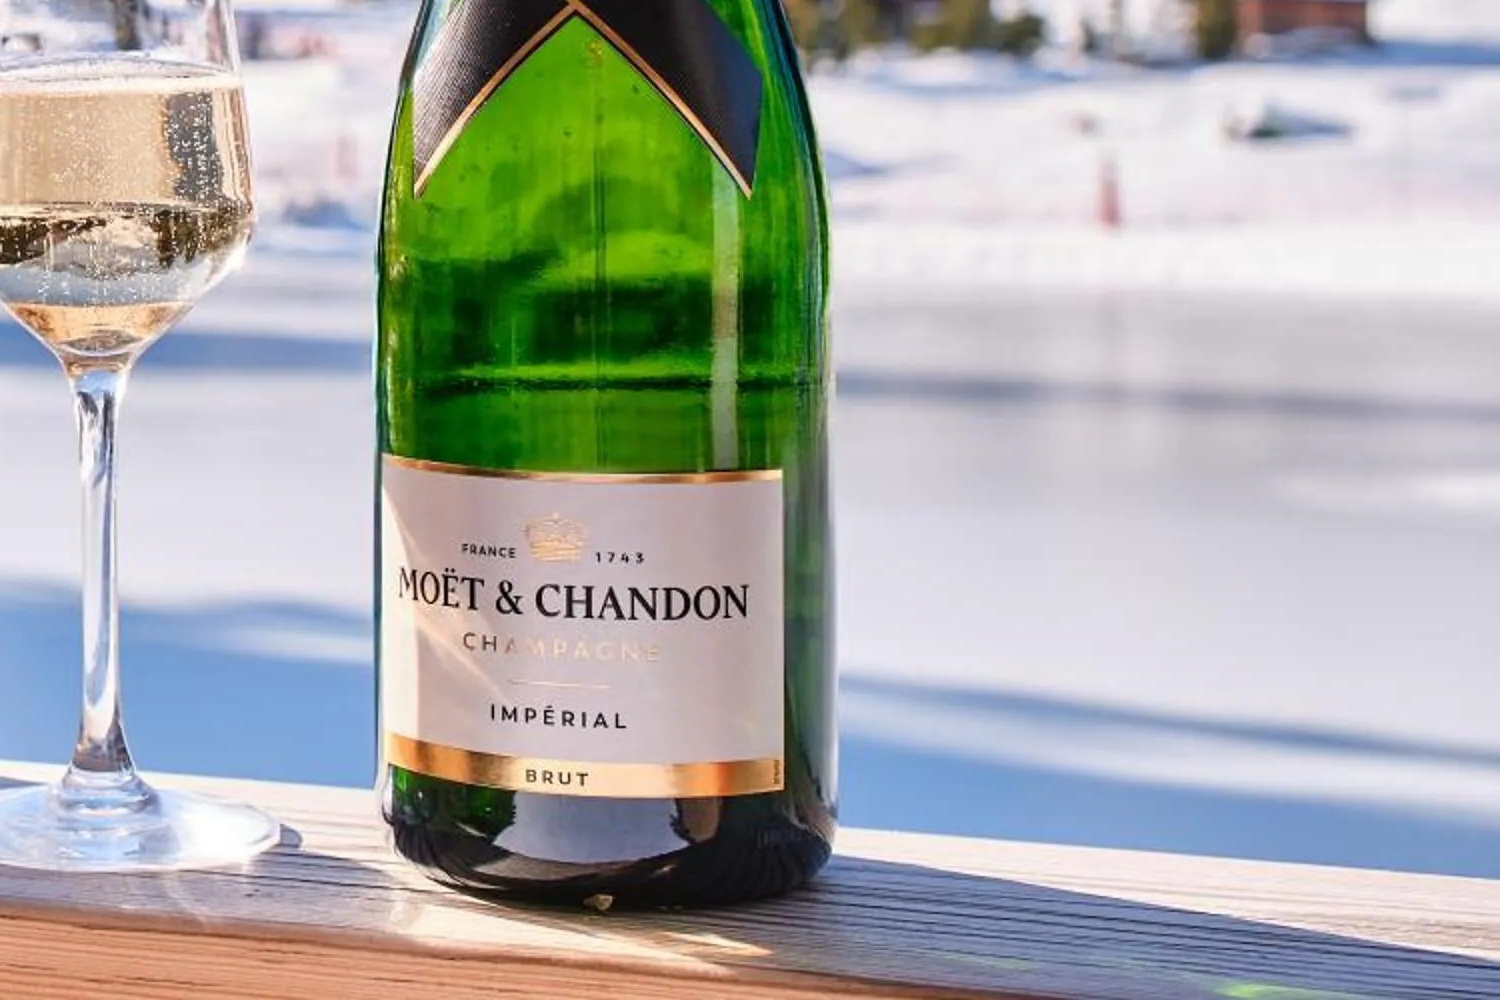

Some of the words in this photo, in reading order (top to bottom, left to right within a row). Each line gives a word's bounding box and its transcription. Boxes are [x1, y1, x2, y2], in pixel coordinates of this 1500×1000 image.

[461, 543, 517, 558] FRANCE
[595, 551, 646, 564] 1743
[399, 566, 485, 612] MOËT
[495, 580, 523, 616] &
[535, 583, 751, 621] CHANDON
[463, 632, 661, 663] CHAMPAGNE
[490, 703, 627, 730] IMPÉRIAL
[525, 769, 589, 787] BRUT
